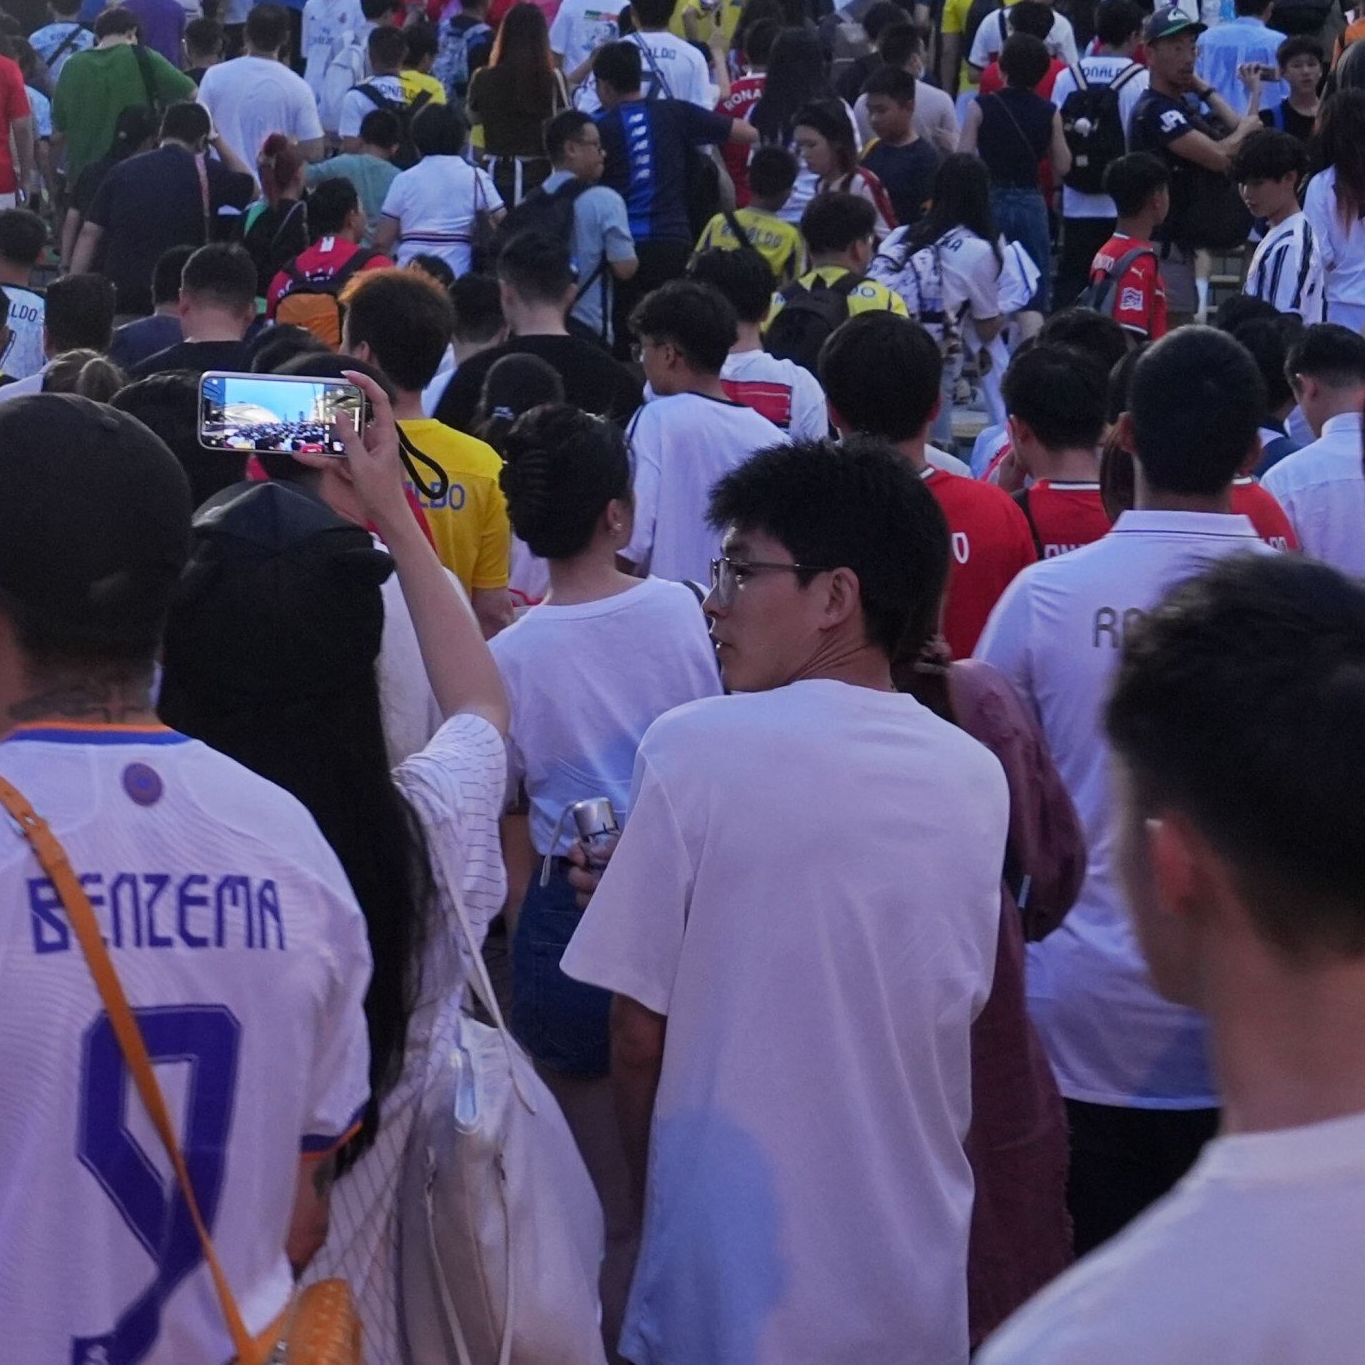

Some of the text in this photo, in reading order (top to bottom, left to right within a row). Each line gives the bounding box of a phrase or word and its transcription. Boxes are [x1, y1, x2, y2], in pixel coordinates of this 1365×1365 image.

[9, 306, 38, 323] LDO
[404, 482, 466, 511] LDO
[26, 872, 286, 954] BENZEMA
[71, 1003, 243, 1365] 9
